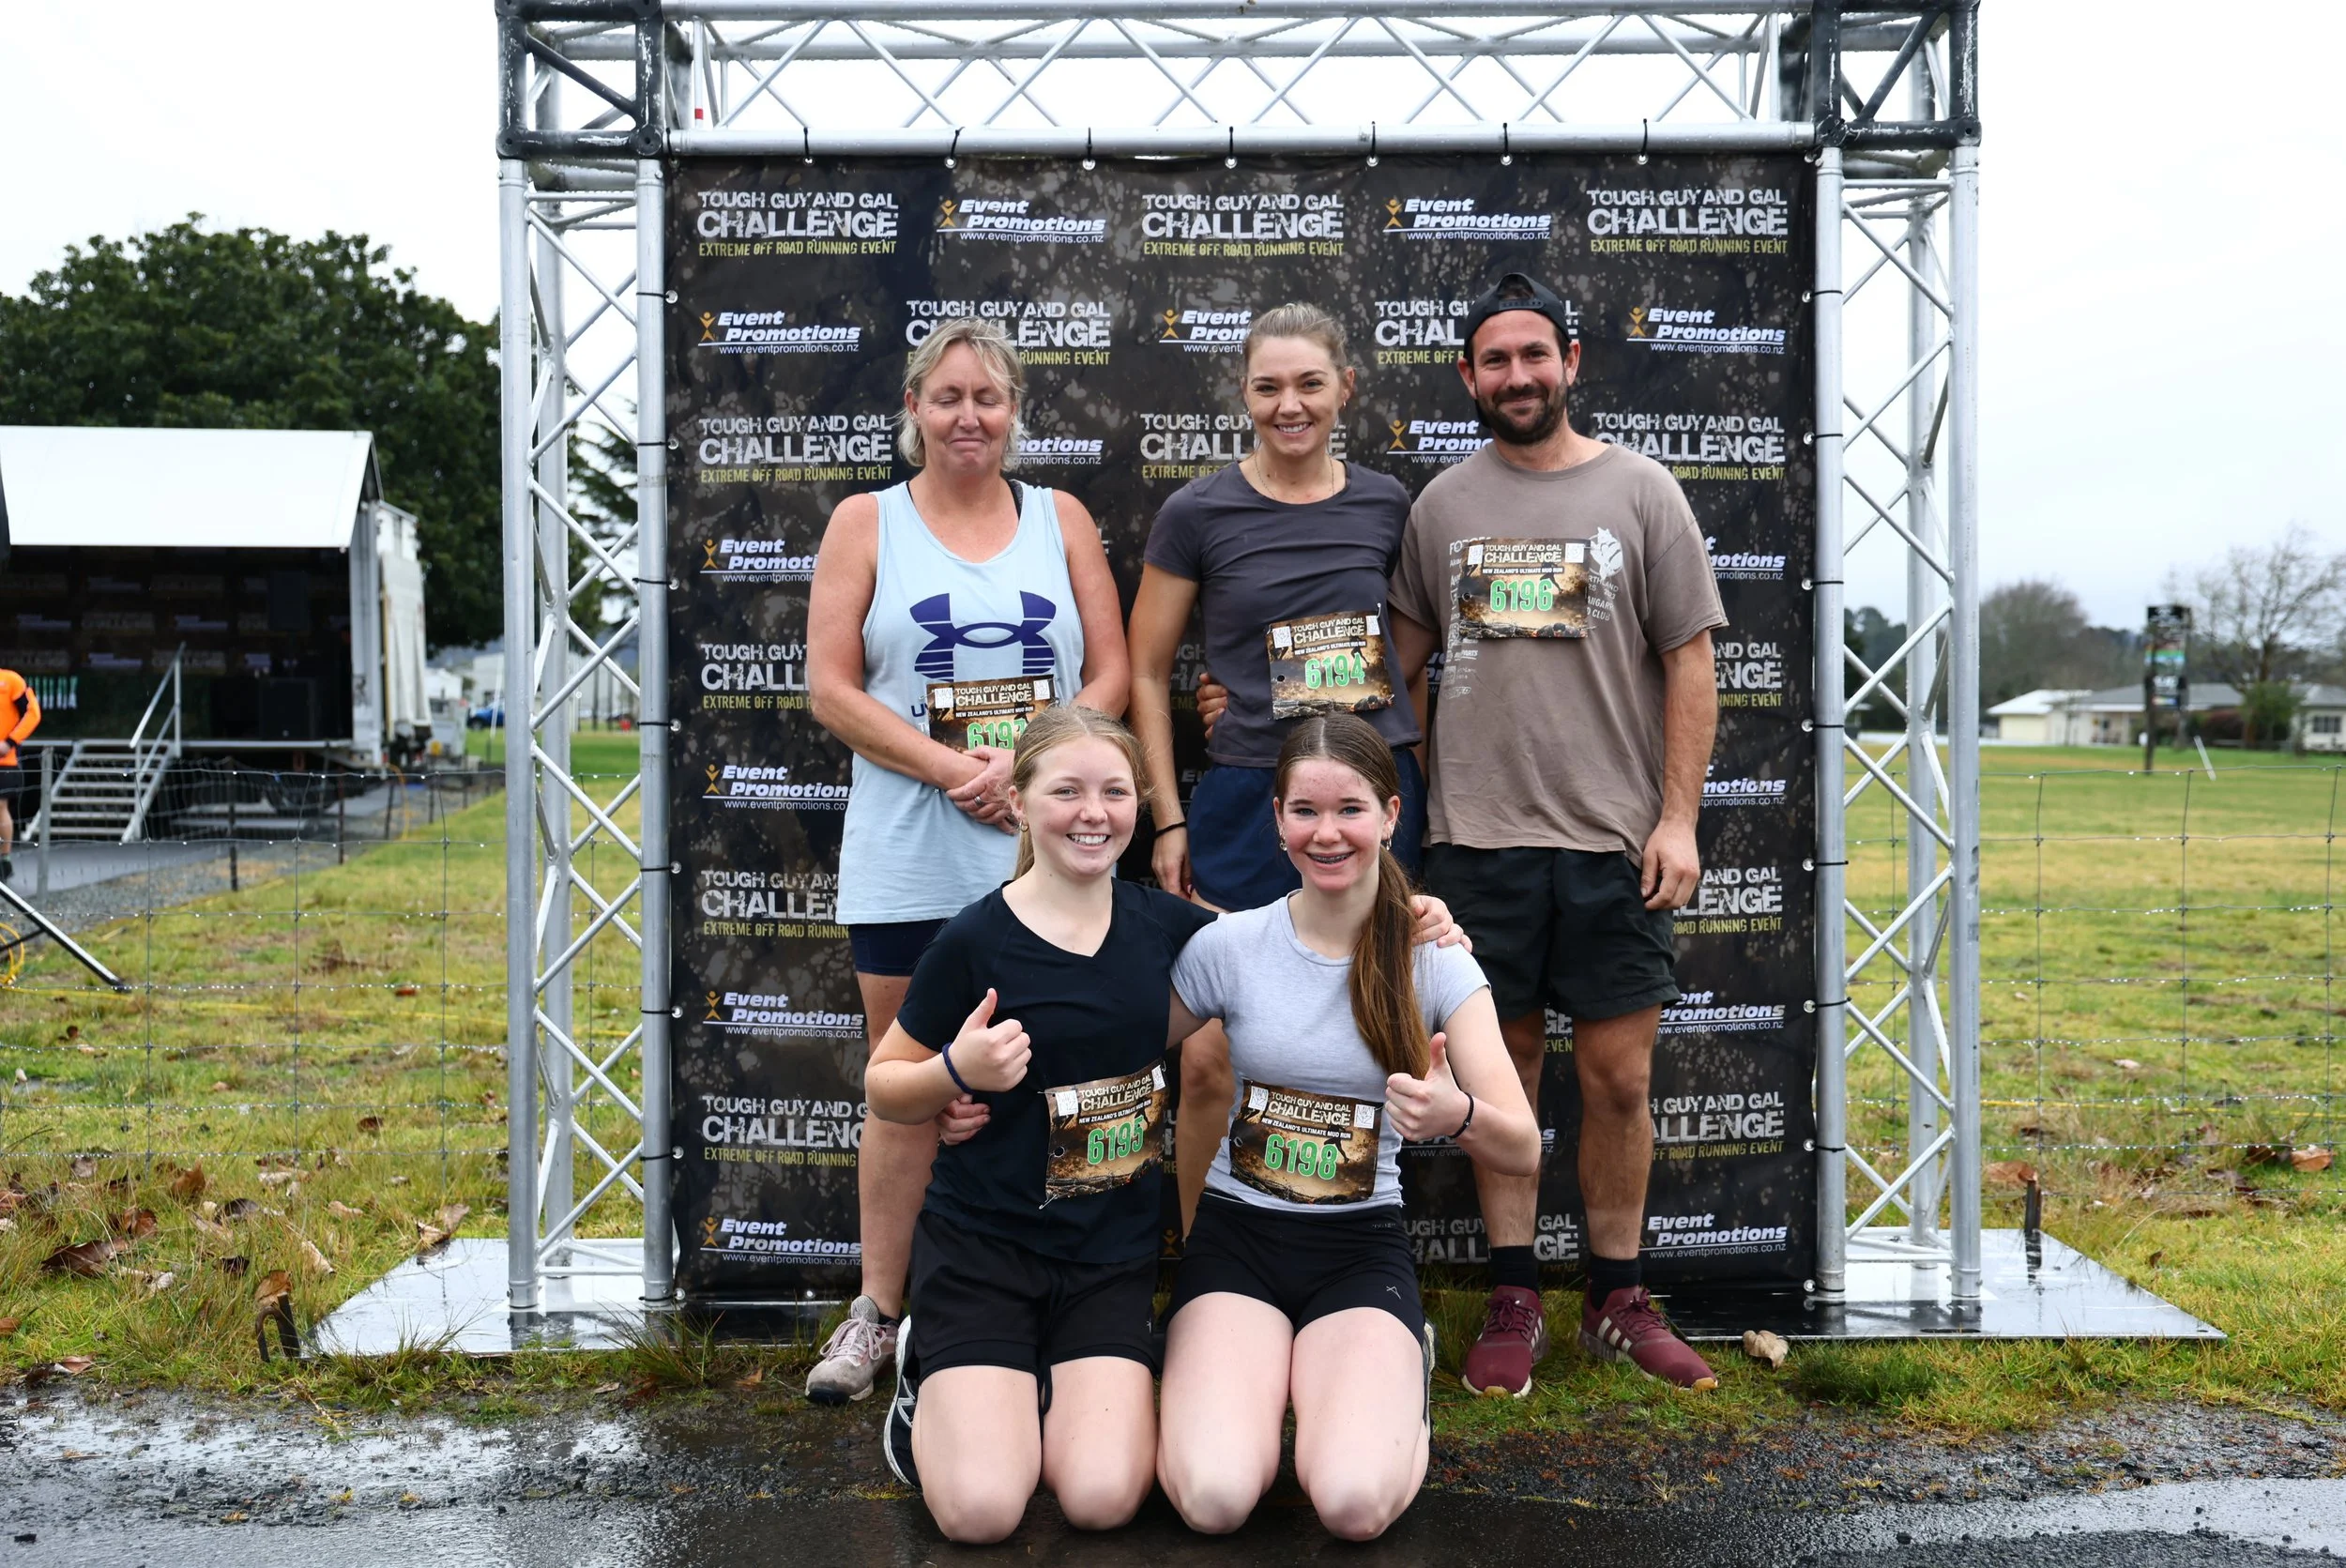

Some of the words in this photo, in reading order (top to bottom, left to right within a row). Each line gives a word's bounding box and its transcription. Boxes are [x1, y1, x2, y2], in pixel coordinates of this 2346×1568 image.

[697, 191, 765, 207] TOUGH
[770, 192, 812, 208] GUY
[813, 193, 854, 208] AND
[860, 193, 899, 208] GAL
[1142, 194, 1211, 210] TOUGH
[1215, 195, 1257, 211] GUY
[1257, 196, 1300, 210] AND
[1304, 195, 1344, 209] GAL
[1405, 199, 1474, 212] Event
[1586, 190, 1654, 206] TOUGH
[1659, 189, 1701, 206] GUY
[1702, 190, 1744, 206] AND
[1749, 191, 1788, 206] GAL
[959, 200, 1029, 214] Event
[697, 210, 898, 237] CHALLENGE
[967, 215, 1106, 232] Promotions
[1143, 212, 1344, 239] CHALLENGE
[1413, 215, 1551, 228] Promotions
[1588, 207, 1789, 236] CHALLENGE
[960, 233, 1104, 243] www.eventpromotions.co.nz
[1408, 231, 1551, 242] www.eventpromotions.co.nz
[699, 243, 750, 256] EXTREME
[754, 242, 772, 255] OFF
[776, 241, 803, 254] ROAD
[806, 241, 857, 254] RUNNING
[861, 240, 896, 254] EVENT
[1144, 242, 1196, 255] EXTREME
[1200, 244, 1219, 256] OFF
[1223, 244, 1251, 256] ROAD
[1254, 242, 1305, 256] RUNNING
[1309, 241, 1343, 255] EVENT
[1591, 238, 1642, 252] EXTREME
[1646, 239, 1666, 252] OFF
[1669, 239, 1697, 252] ROAD
[1699, 239, 1750, 252] RUNNING
[1753, 239, 1787, 253] EVENT
[906, 300, 975, 316] TOUGH
[980, 300, 1022, 317] GUY
[1023, 303, 1066, 318] AND
[1071, 302, 1111, 318] GAL
[1375, 301, 1443, 316] TOUGH
[718, 312, 785, 327] Event
[1181, 312, 1252, 325] Event
[1649, 310, 1714, 324] Event
[724, 327, 861, 342] Promotions
[1657, 326, 1786, 342] Promotions
[719, 344, 859, 354] www.eventpromotions.co.nz
[1651, 343, 1784, 354] www.eventpromotions.co.nz
[1074, 351, 1109, 365] EVENT
[1378, 350, 1429, 364] EXTREME
[1435, 351, 1455, 364] OFF
[698, 418, 762, 434] TOUGH
[766, 416, 806, 434] GUY
[807, 417, 848, 433] AND
[853, 415, 892, 432] GAL
[1140, 414, 1210, 430] TOUGH
[1409, 420, 1479, 434] Event
[1594, 412, 1659, 430] TOUGH
[1664, 414, 1704, 432] GUY
[1704, 417, 1744, 433] AND
[1747, 417, 1785, 434] GAL
[698, 435, 892, 465] CHALLENGE
[701, 468, 749, 483] EXTREME
[753, 469, 771, 482] OFF
[774, 468, 801, 481] ROAD
[804, 466, 853, 481] RUNNING
[857, 465, 891, 480] EVENT
[1142, 464, 1195, 479] EXTREME
[1700, 466, 1748, 480] RUNNING
[1751, 465, 1784, 480] EVENT
[720, 540, 785, 554] Event
[1485, 552, 1562, 563] CHALLENGE
[1490, 578, 1554, 612] 6196
[1292, 622, 1318, 632] TOUGH
[1320, 620, 1335, 629] GUY
[1293, 625, 1365, 644] CHALLENGE
[700, 644, 764, 661] TOUGH
[1747, 642, 1782, 659] GAL
[1304, 652, 1365, 690] 6194
[955, 687, 983, 695] TOUGH
[983, 686, 999, 694] GUY
[999, 684, 1016, 693] AND
[703, 695, 751, 708] EXTREME
[754, 695, 772, 709] OFF
[776, 695, 802, 709] ROAD
[955, 691, 1032, 707] CHALLENGE
[1751, 693, 1782, 707] EVENT
[722, 767, 787, 781] Event
[700, 870, 766, 888] TOUGH
[769, 873, 809, 890] GUY
[1702, 869, 1742, 886] AND
[1745, 866, 1782, 884] GAL
[703, 921, 751, 936] EXTREME
[755, 923, 774, 936] OFF
[778, 923, 804, 937] ROAD
[1699, 919, 1746, 934] RUNNING
[1750, 916, 1782, 932] EVENT
[724, 993, 789, 1008] Event
[731, 1009, 863, 1027] Promotions
[725, 1027, 862, 1038] www.eventpromotions.co.nz
[1081, 1087, 1109, 1098] TOUGH
[1110, 1083, 1126, 1094] GUY
[1126, 1079, 1141, 1089] AND
[1141, 1074, 1151, 1085] GAL
[1081, 1084, 1151, 1111] CHALLENGE
[1271, 1091, 1297, 1104] TOUGH
[1297, 1098, 1314, 1107] GUY
[1314, 1101, 1333, 1111] AND
[1334, 1103, 1351, 1113] GAL
[1663, 1096, 1702, 1114] GUY
[1704, 1095, 1744, 1112] AND
[1748, 1091, 1784, 1109] GAL
[701, 1095, 766, 1115] TOUGH
[769, 1099, 810, 1116] GUY
[812, 1102, 851, 1118] AND
[1268, 1101, 1351, 1126] CHALLENGE
[1087, 1115, 1144, 1165] 6195
[704, 1147, 753, 1163] EXTREME
[755, 1149, 774, 1164] OFF
[777, 1150, 804, 1165] ROAD
[807, 1151, 856, 1166] RUNNING
[1265, 1134, 1339, 1180] 6198
[1669, 1146, 1695, 1160] ROAD
[1699, 1143, 1746, 1157] RUNNING
[1749, 1140, 1783, 1154] EVENT
[720, 1221, 787, 1236] Event
[1538, 1213, 1577, 1231] GAL
[1648, 1214, 1714, 1230] Event
[1656, 1225, 1788, 1247] Promotions
[728, 1236, 862, 1255] Promotions
[1650, 1243, 1787, 1257] www.eventpromotions.co.nz
